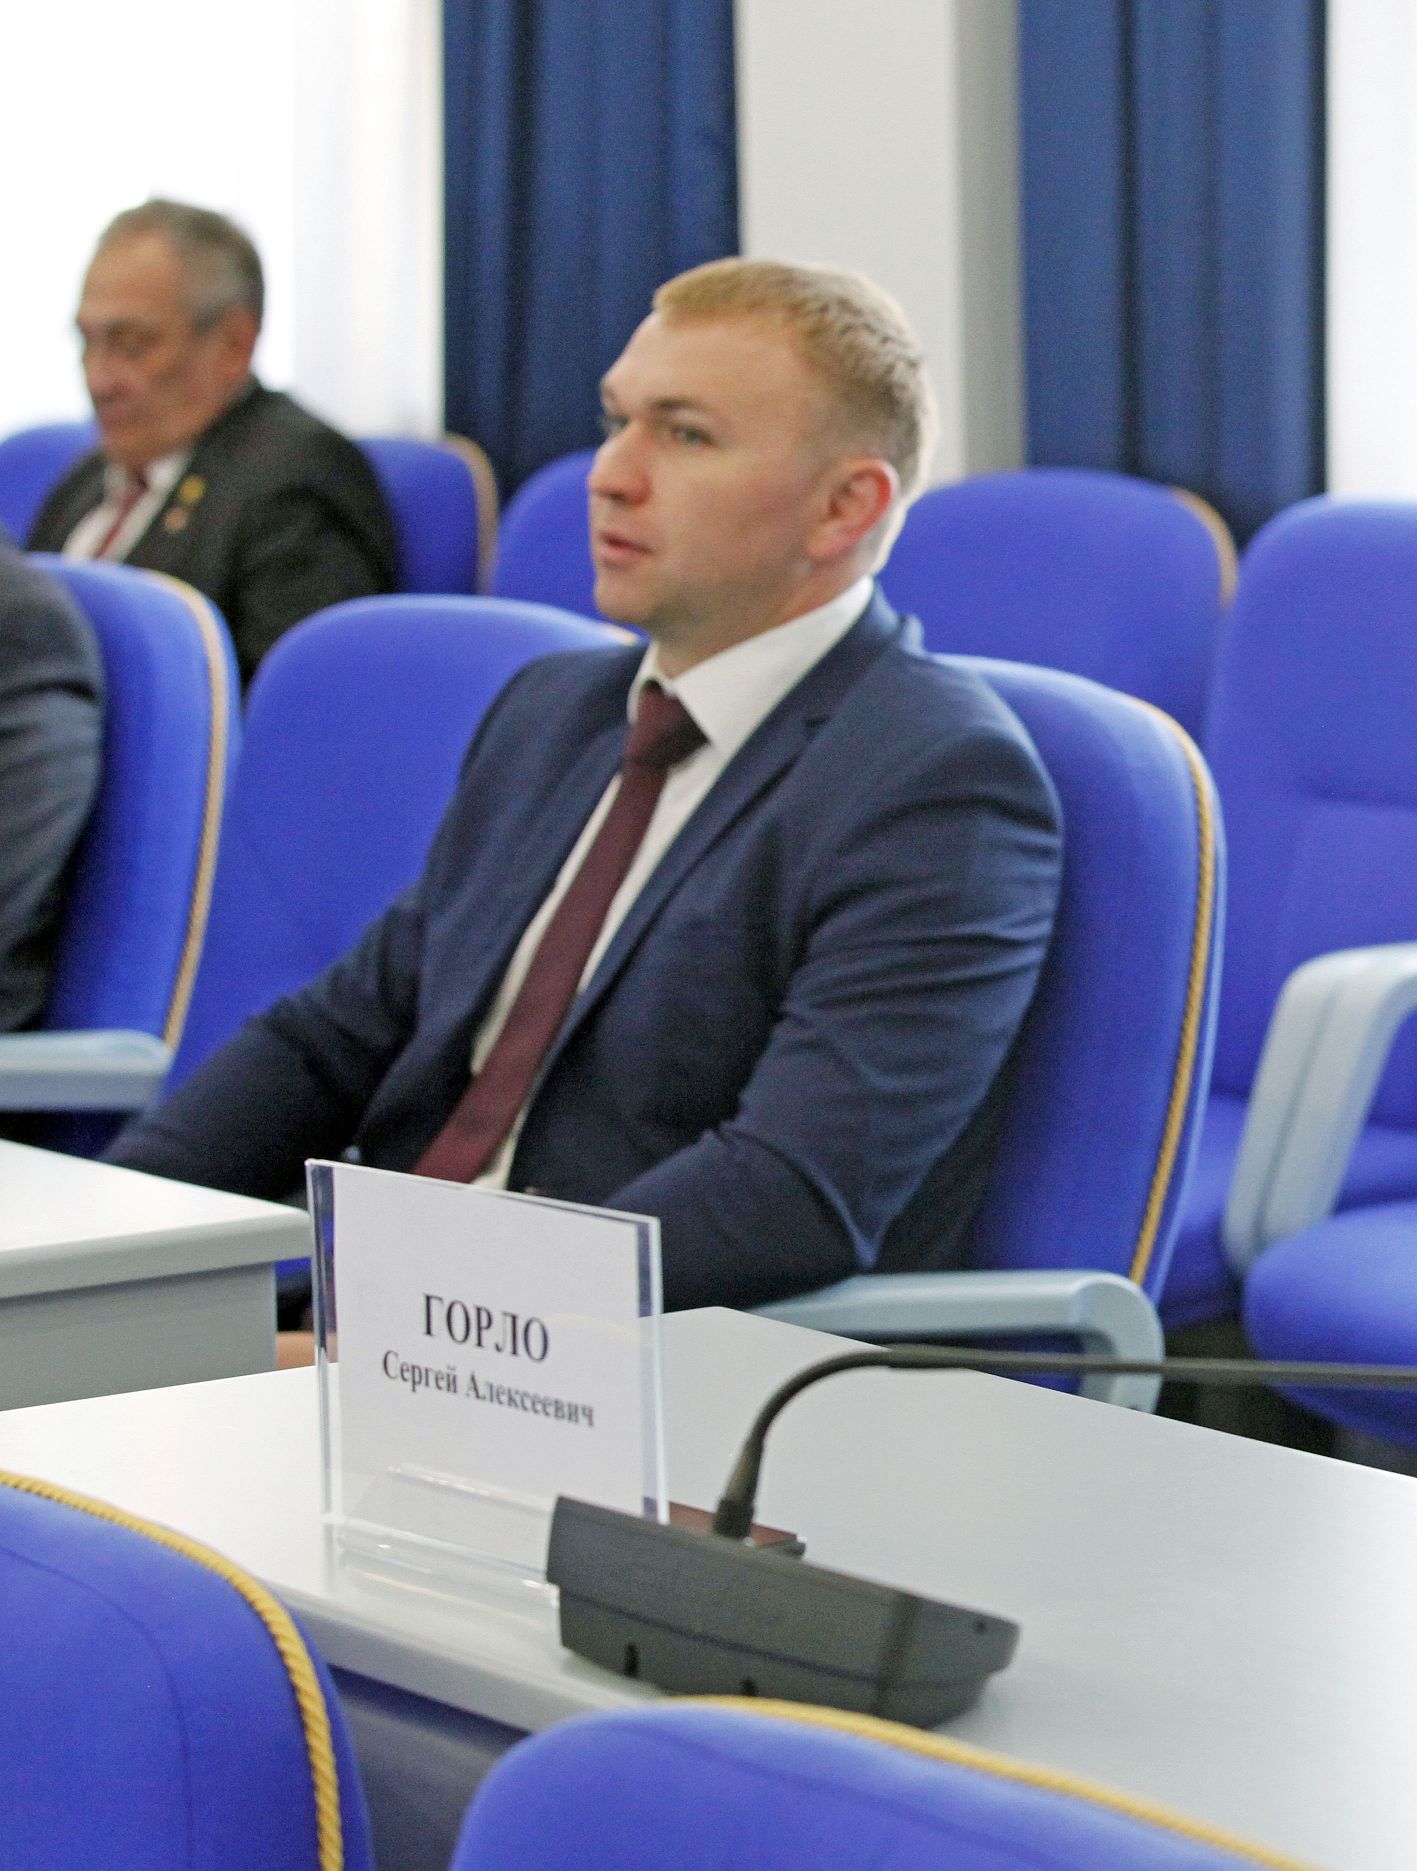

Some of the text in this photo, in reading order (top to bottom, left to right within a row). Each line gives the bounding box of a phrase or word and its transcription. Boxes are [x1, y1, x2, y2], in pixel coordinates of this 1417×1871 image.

[423, 1293, 549, 1362] ГОРЛО
[383, 1350, 595, 1427] Сергей Алексеевич
